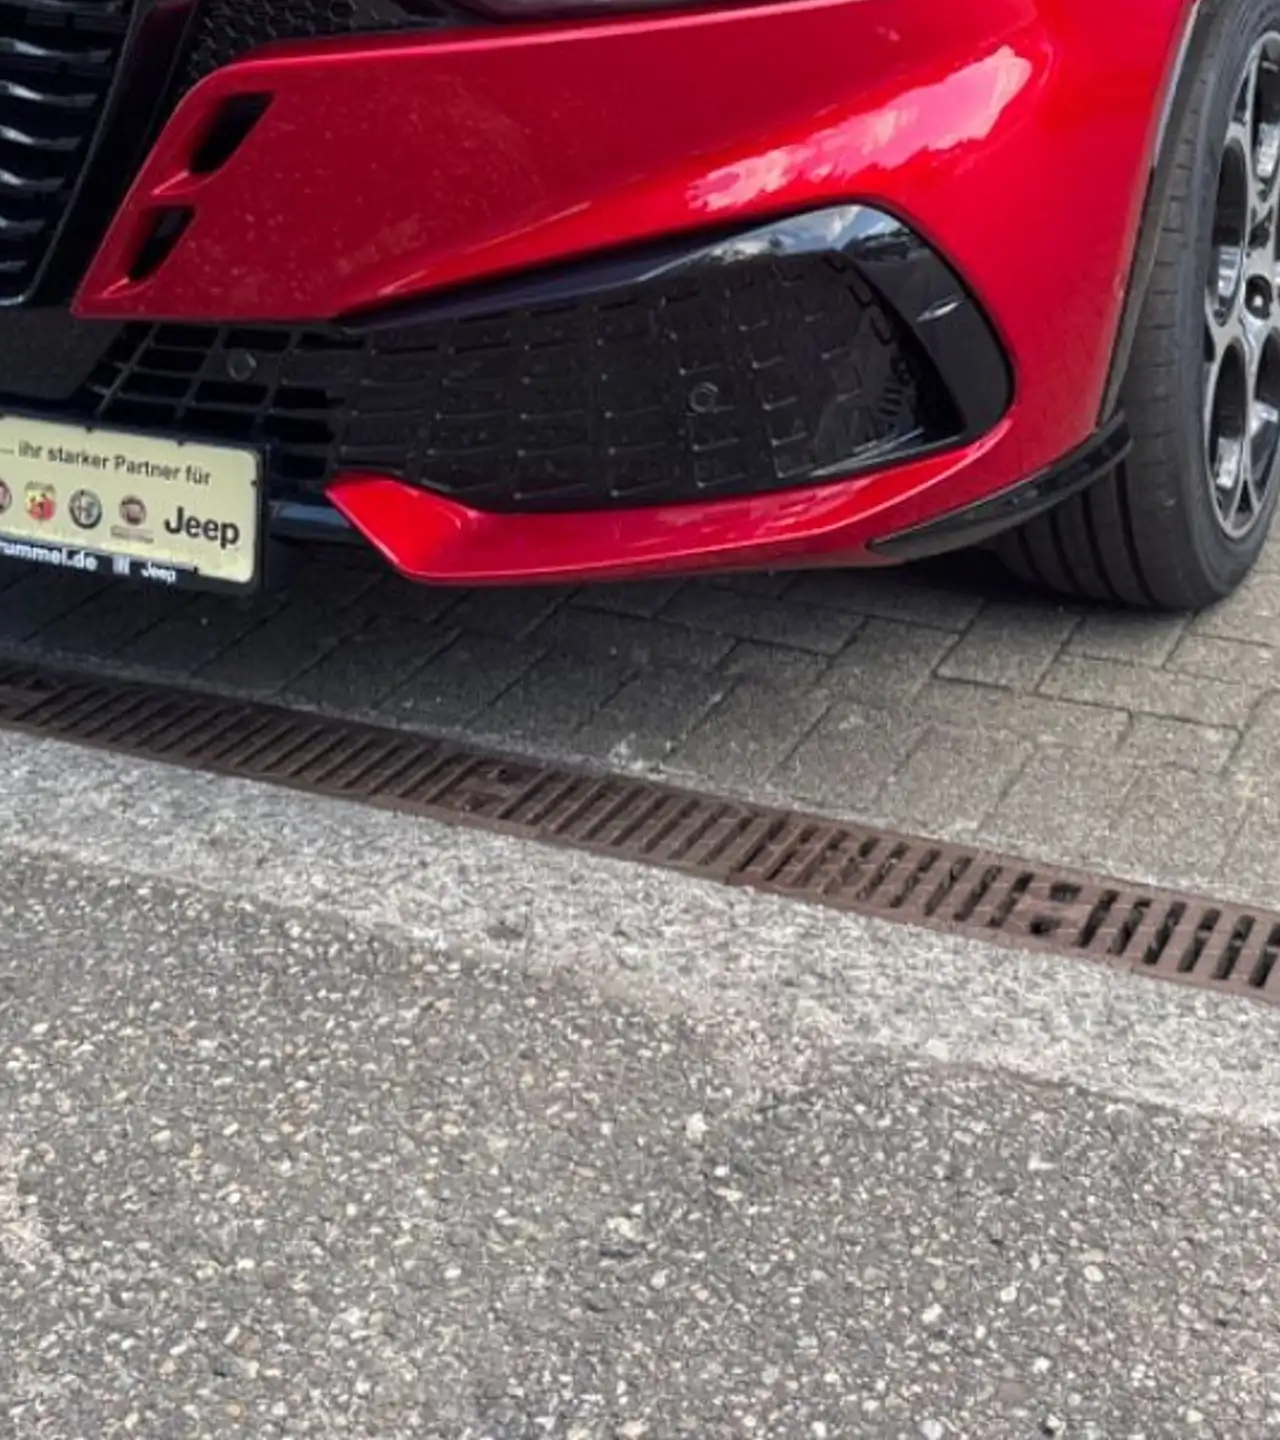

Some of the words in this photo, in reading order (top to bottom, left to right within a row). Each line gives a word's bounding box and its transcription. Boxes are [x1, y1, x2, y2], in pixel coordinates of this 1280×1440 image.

[47, 446, 110, 471] starker
[113, 454, 181, 482] Partner
[186, 464, 212, 486] für
[164, 506, 241, 549] Jeep
[140, 560, 176, 584] Jeep
